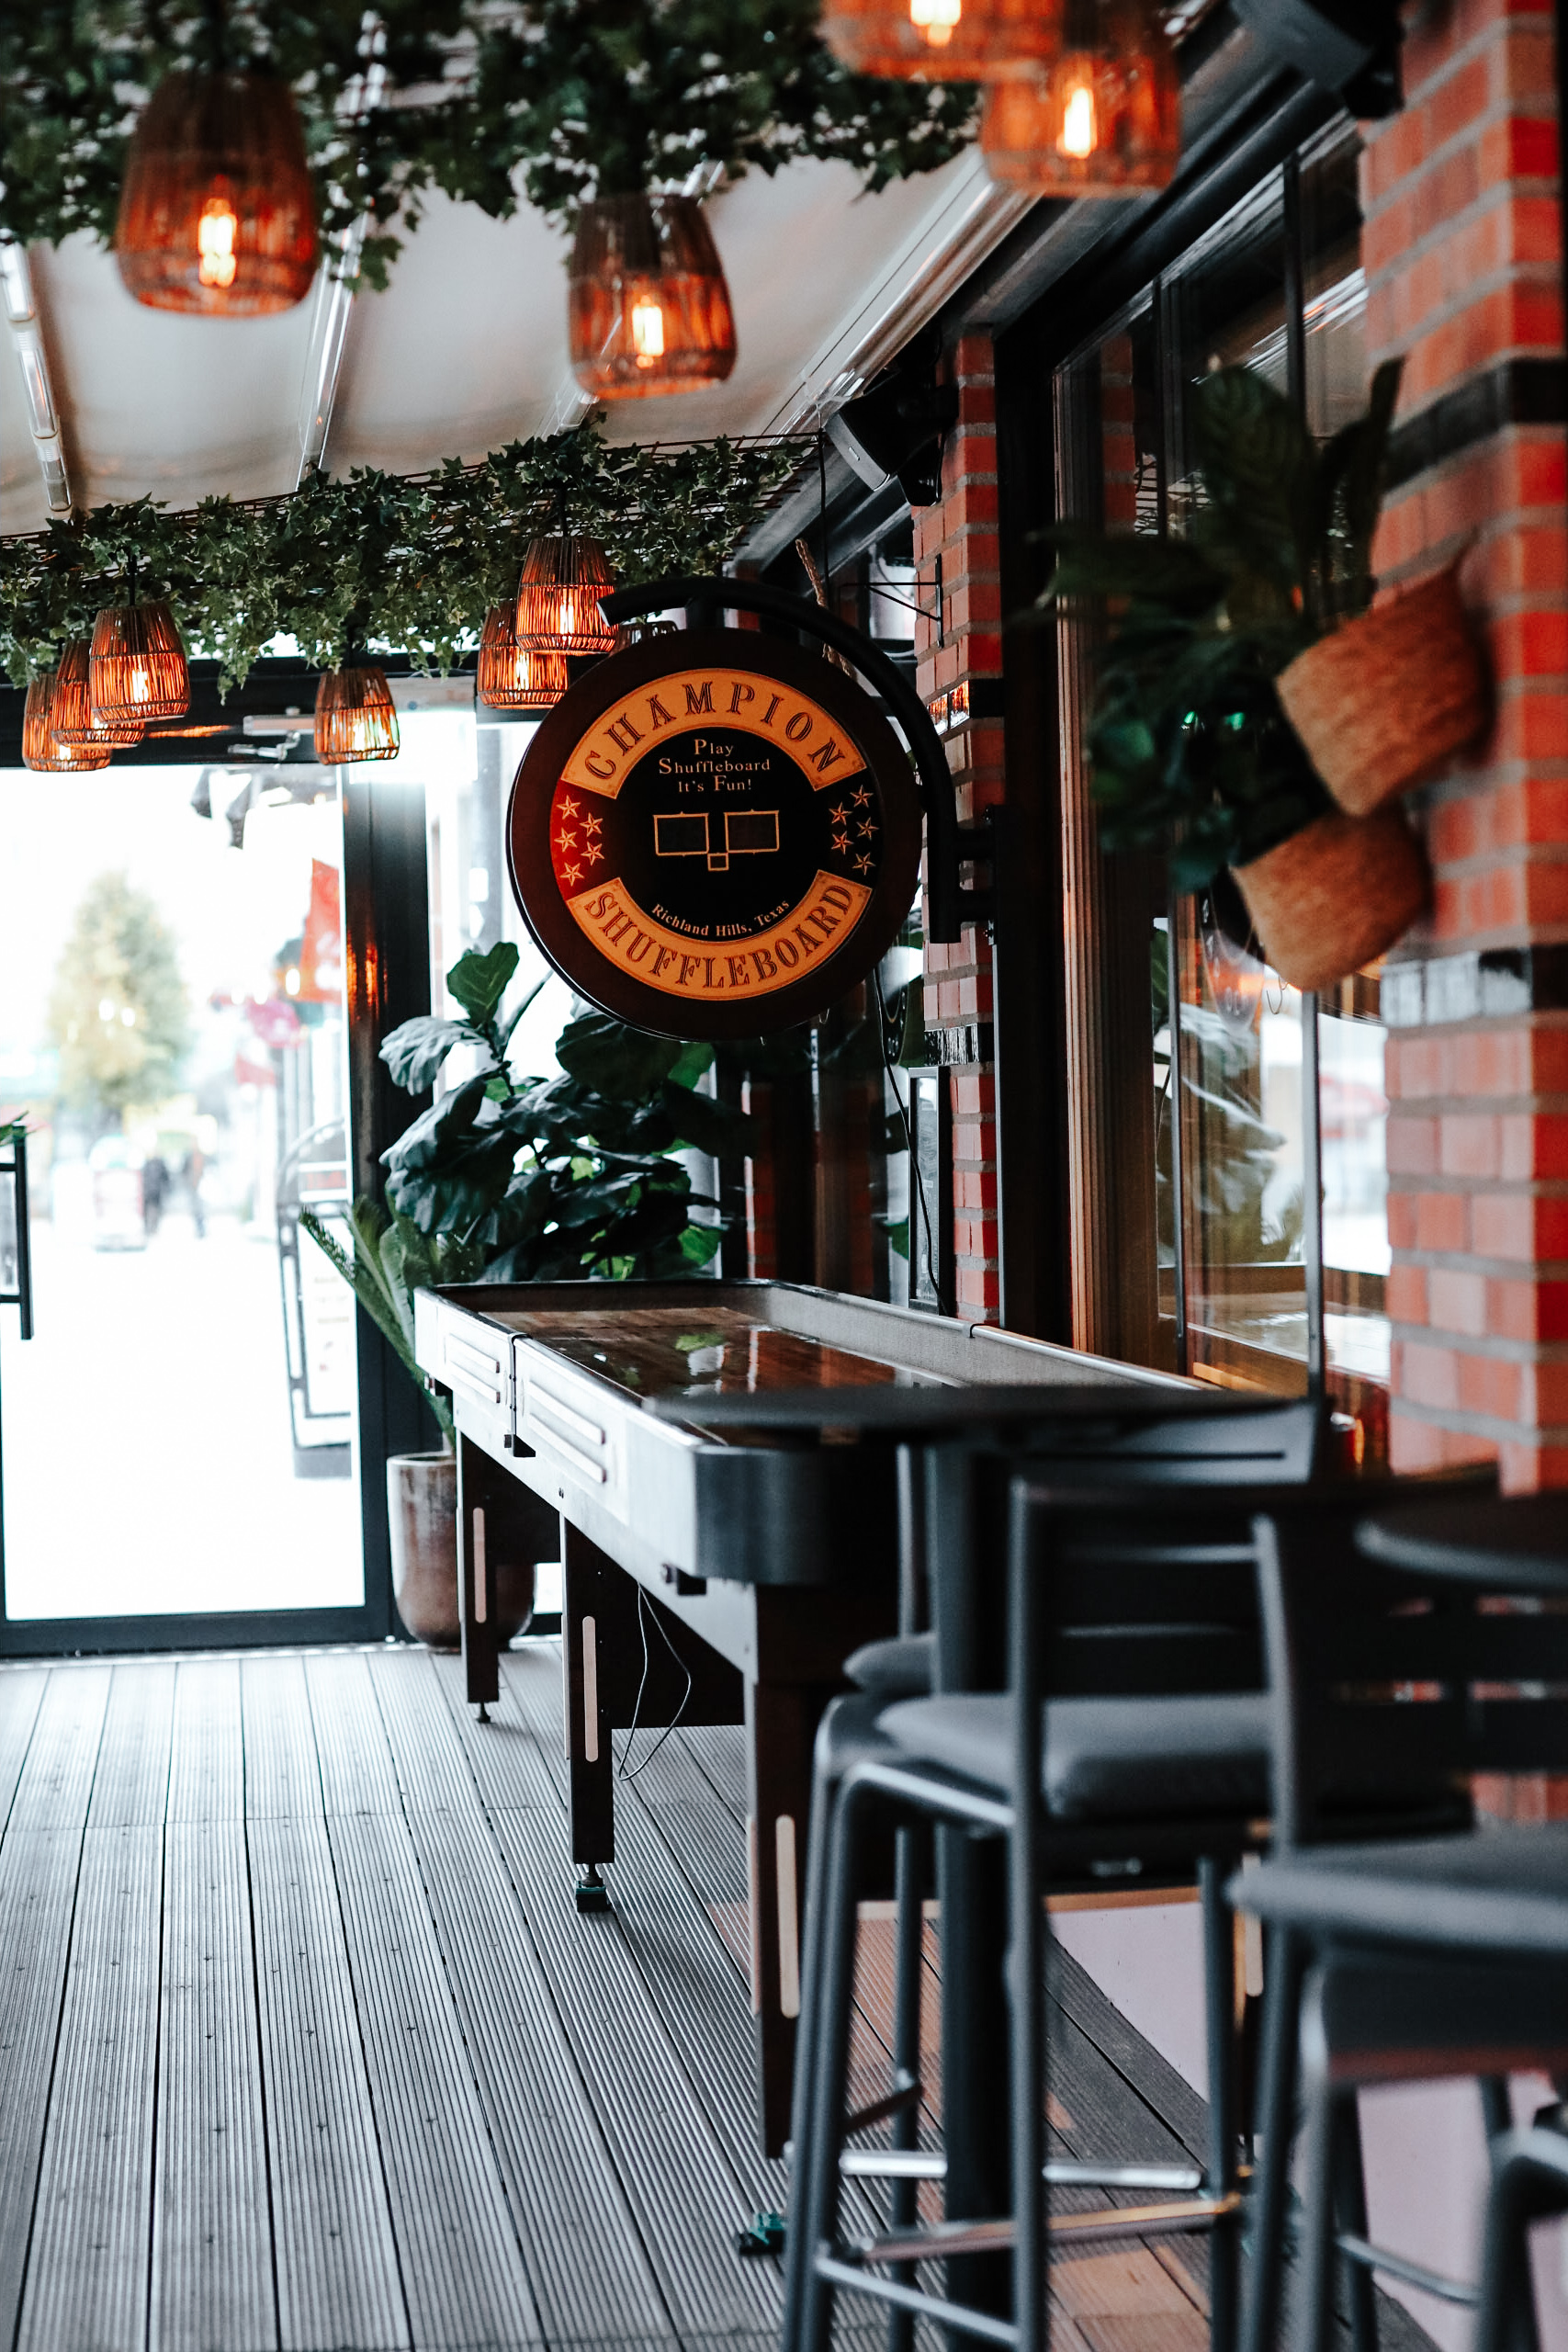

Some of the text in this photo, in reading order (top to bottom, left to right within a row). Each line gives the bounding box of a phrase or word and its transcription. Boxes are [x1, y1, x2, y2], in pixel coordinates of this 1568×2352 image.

[585, 681, 845, 779] CHAMPION
[694, 739, 734, 757] Play
[659, 759, 771, 775] Shuffleboard
[678, 775, 752, 793] It's Fun!
[651, 900, 790, 937] Richland Hills, Texas
[584, 885, 852, 988] SHUFFLEBOARD
